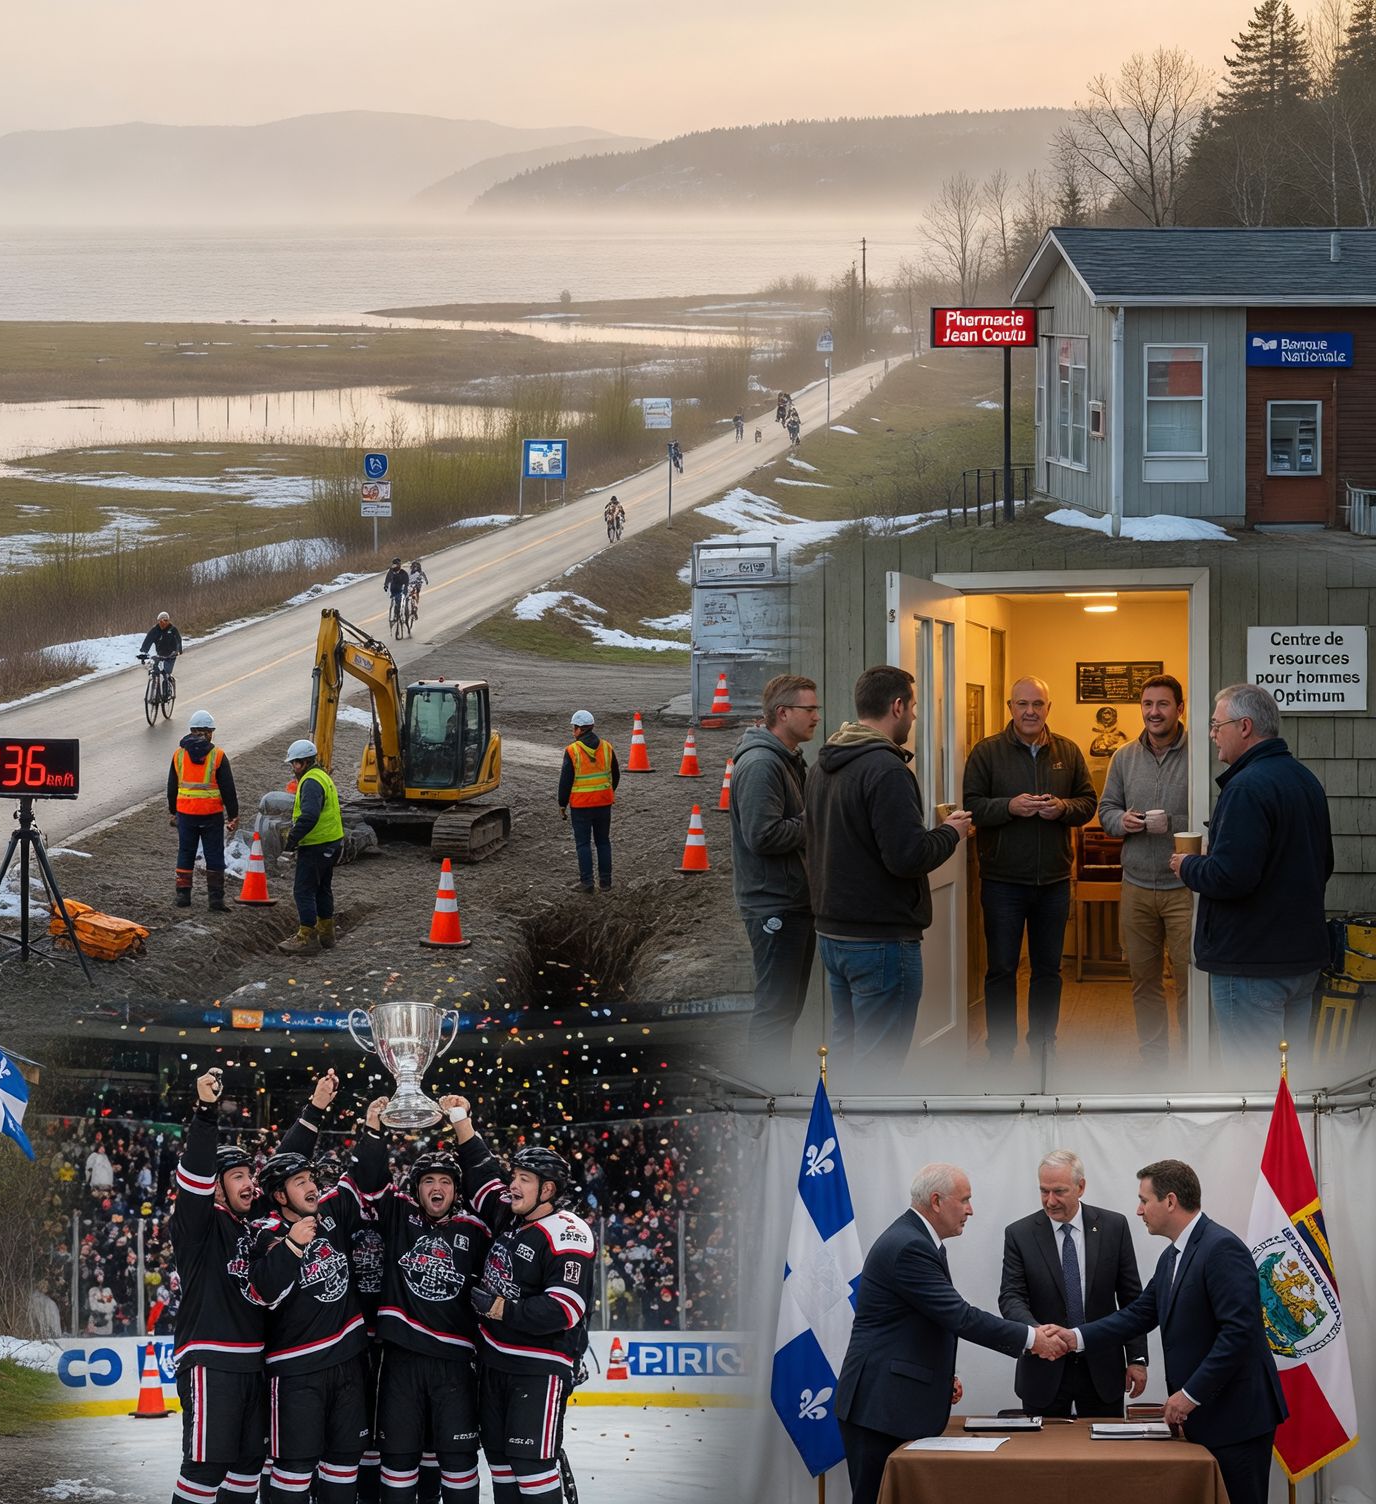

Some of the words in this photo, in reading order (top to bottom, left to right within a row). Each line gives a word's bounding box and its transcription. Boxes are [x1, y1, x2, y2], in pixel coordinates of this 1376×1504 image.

[943, 328, 978, 342] Jean
[1270, 631, 1321, 646] Centre
[1324, 631, 1344, 646] de
[1269, 654, 1350, 665] resources
[1255, 673, 1293, 685] pour
[1296, 670, 1361, 684] hommes
[1273, 688, 1345, 706] Optimum
